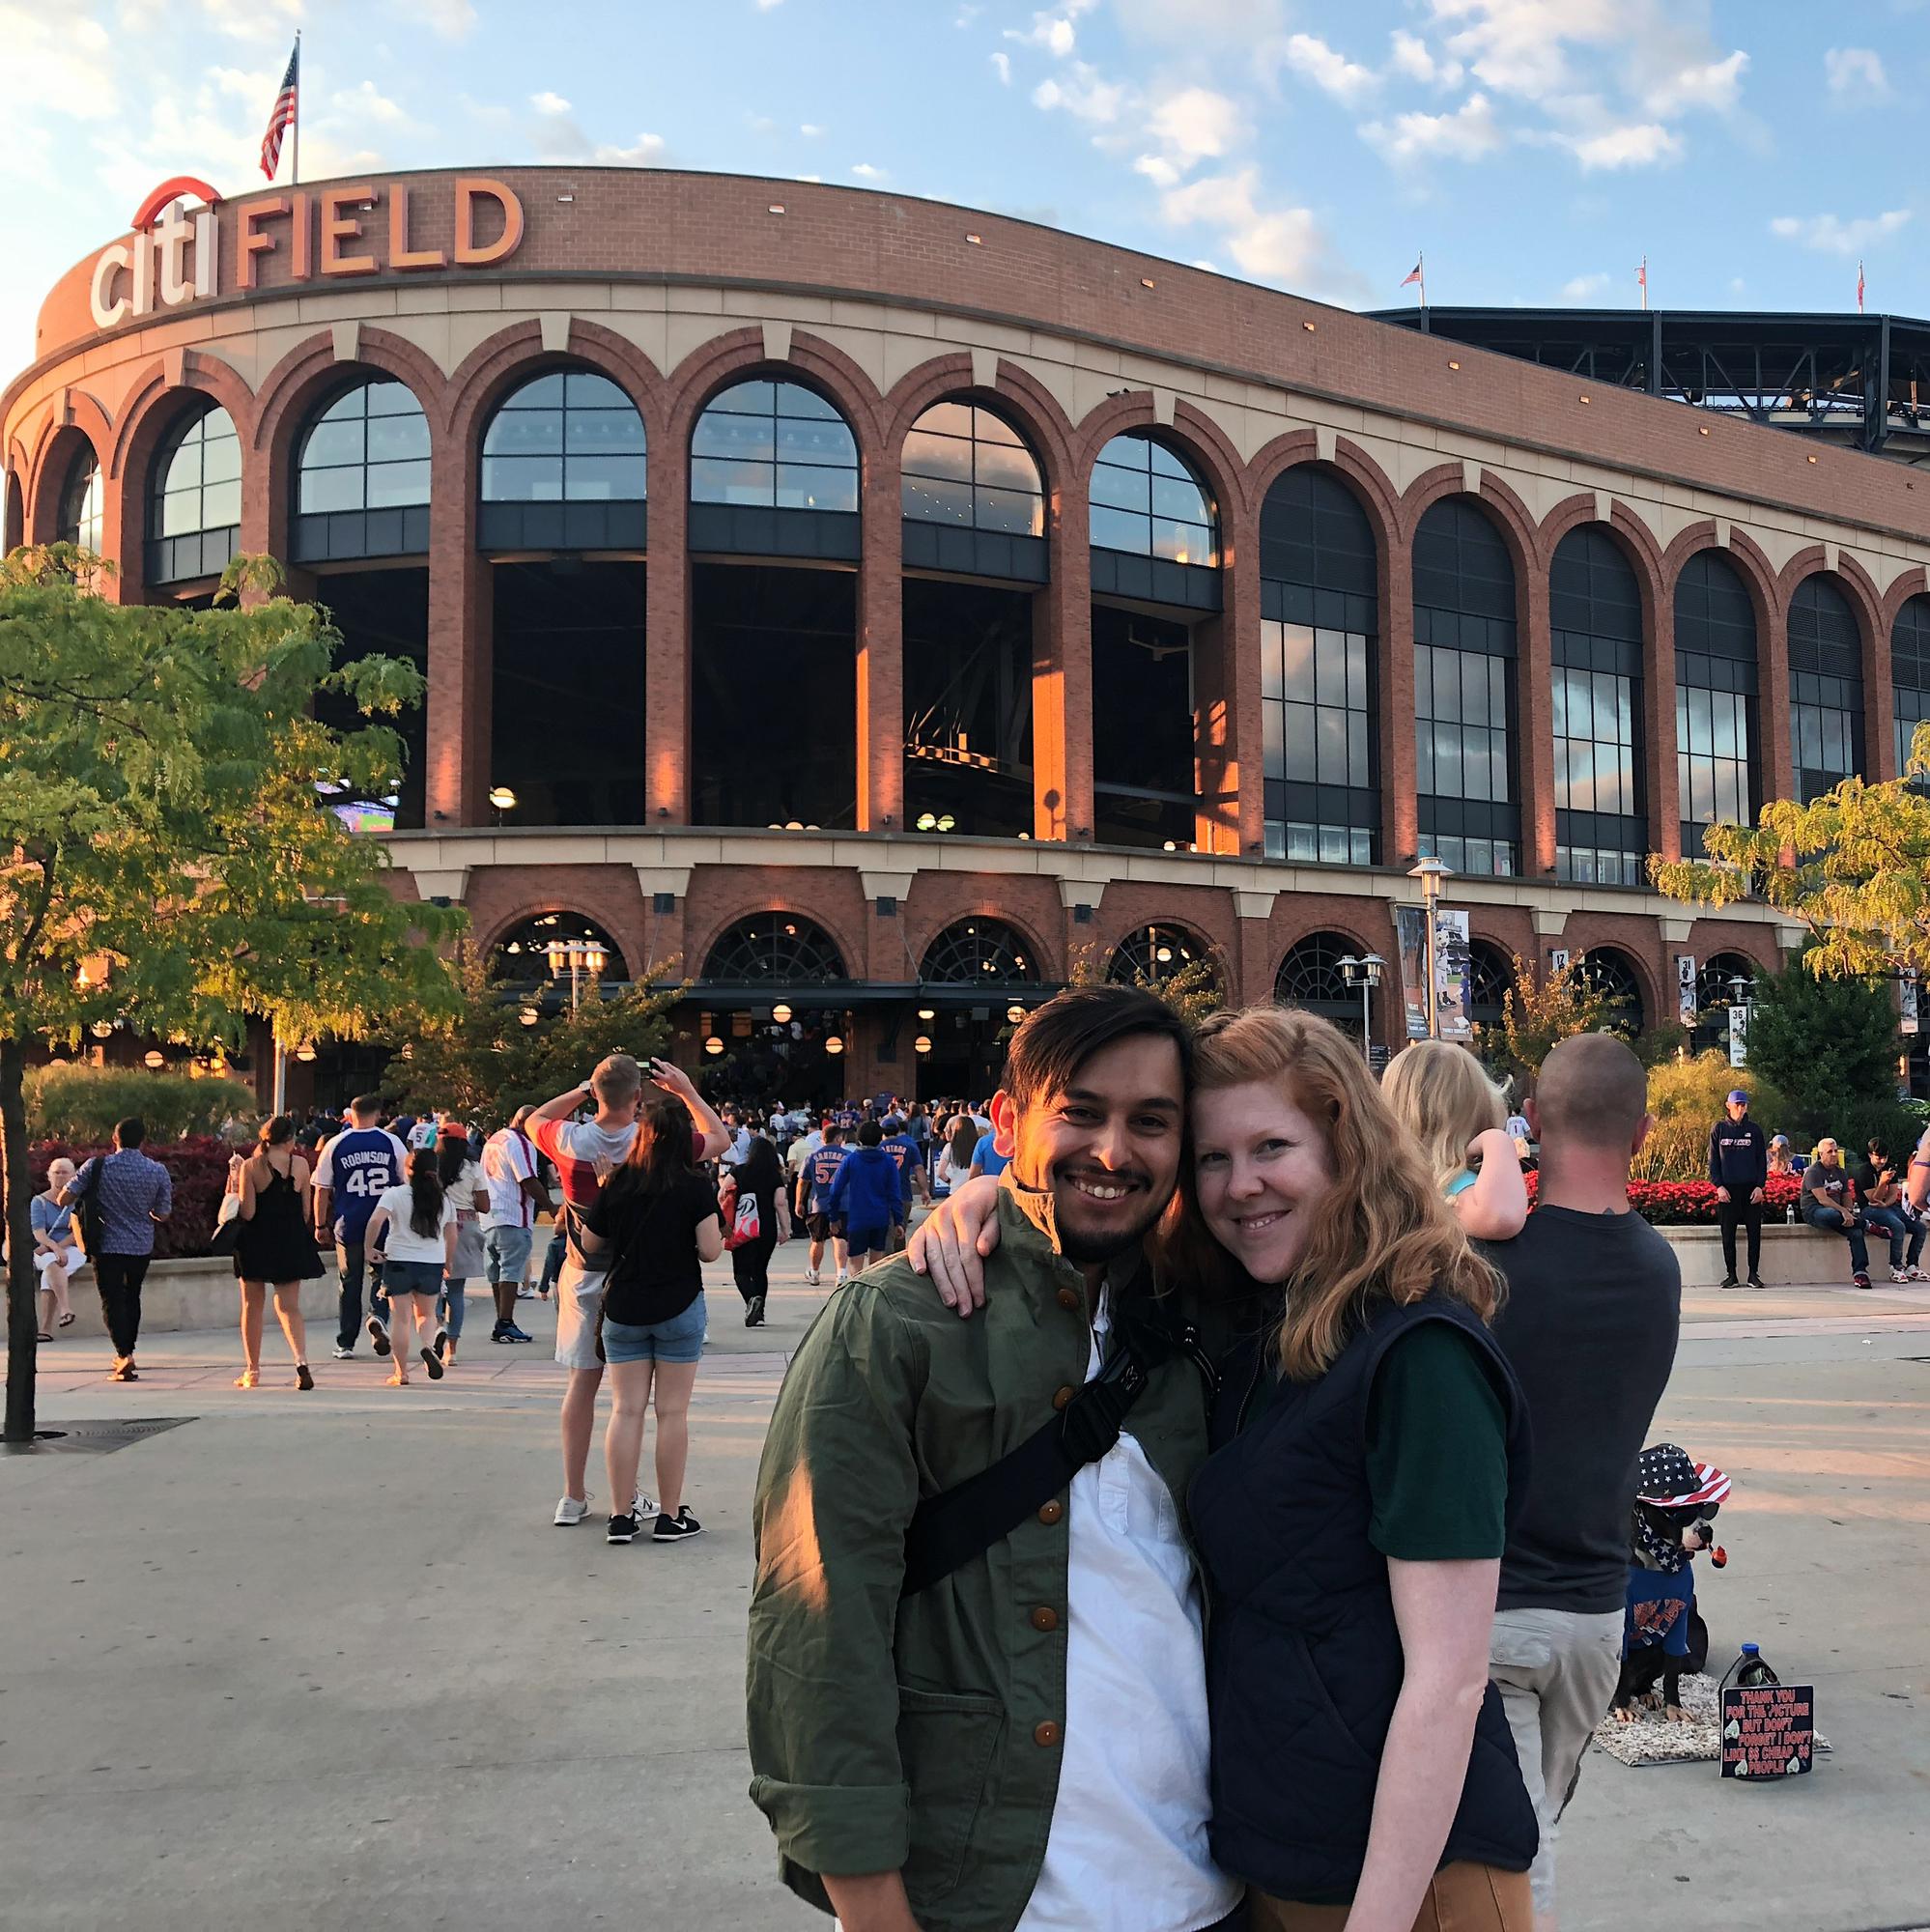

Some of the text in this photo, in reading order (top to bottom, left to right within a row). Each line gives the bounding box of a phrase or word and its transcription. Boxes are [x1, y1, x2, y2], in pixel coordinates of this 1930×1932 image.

[90, 176, 525, 328] citi FIELD
[1682, 960, 1690, 970] 31
[1732, 1009, 1743, 1020] 36
[415, 1131, 423, 1143] 5
[340, 1151, 391, 1169] ROBINSON
[814, 1162, 842, 1184] 57
[346, 1167, 390, 1197] 42
[1741, 1689, 1796, 1704] THANK YOU
[1725, 1705, 1746, 1719] FOR
[1747, 1704, 1767, 1719] THE
[1742, 1717, 1793, 1732] BUT DON'T
[1738, 1730, 1812, 1747] FORGET I DON'T
[1723, 1747, 1746, 1762] LIKE
[1761, 1745, 1794, 1759] CHEAP
[1747, 1759, 1785, 1775] PEOPLE
